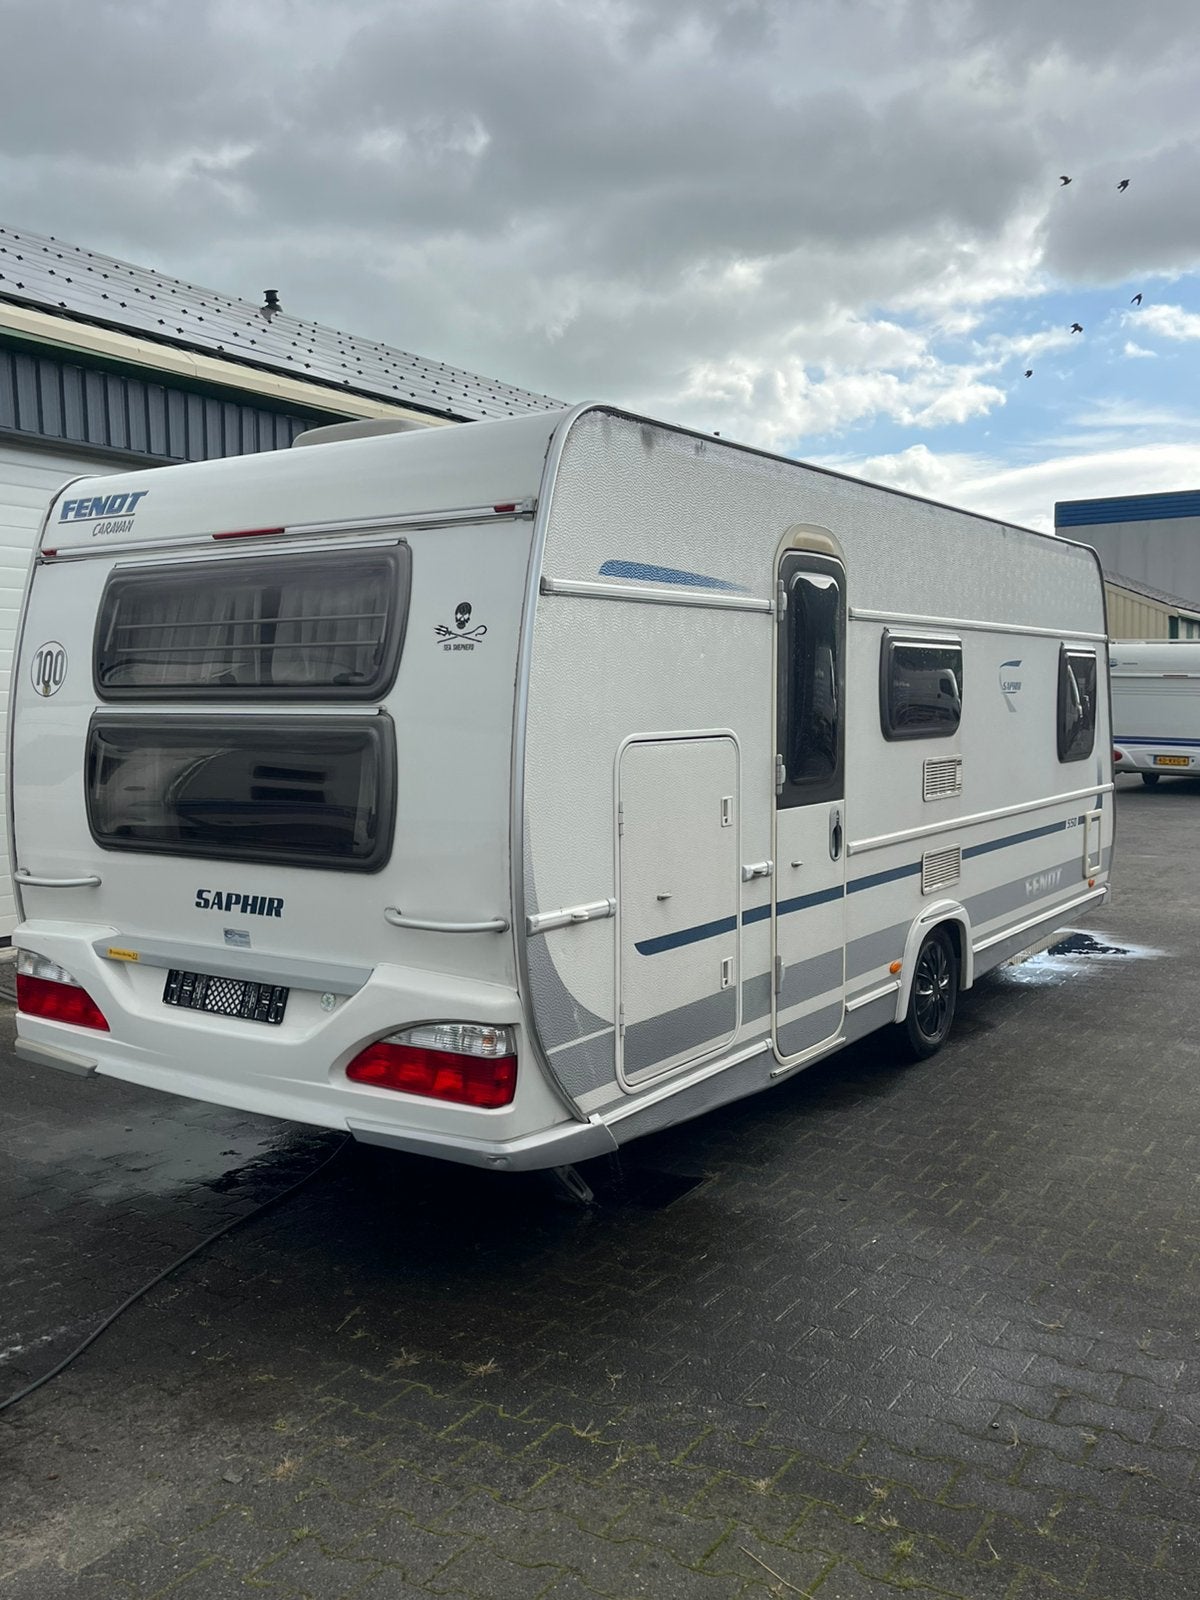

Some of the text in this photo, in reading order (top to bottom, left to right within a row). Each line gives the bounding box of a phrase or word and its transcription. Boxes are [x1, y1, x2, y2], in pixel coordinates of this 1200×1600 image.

[60, 490, 149, 520] FENDT
[92, 519, 134, 537] CARAVAN
[36, 650, 64, 687] 100
[1025, 868, 1062, 898] FENDT
[195, 888, 284, 918] SAPHIR
